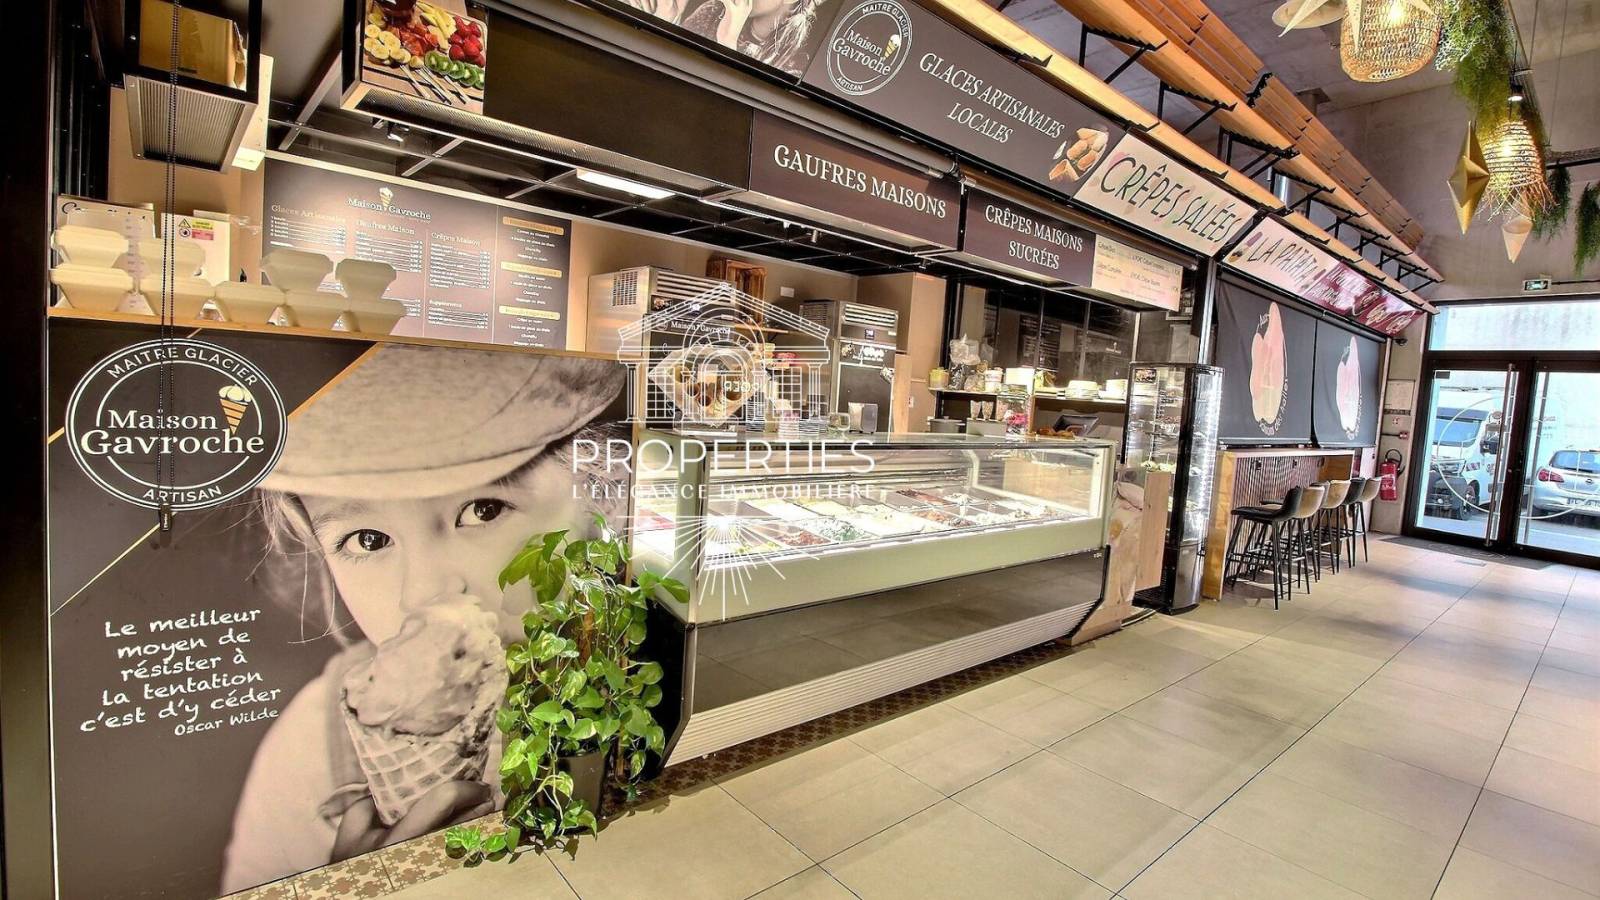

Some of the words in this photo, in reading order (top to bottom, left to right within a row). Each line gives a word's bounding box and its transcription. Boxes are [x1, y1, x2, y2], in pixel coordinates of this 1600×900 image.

[832, 37, 892, 77] Gavroche
[847, 29, 883, 57] Maison
[836, 76, 863, 92] ARTISAN
[919, 52, 983, 97] GLACES
[978, 84, 1066, 138] ARTISANALES
[947, 102, 1014, 144] LOCALES
[774, 143, 867, 193] GAUFRES
[870, 178, 946, 219] MAISONS
[347, 197, 383, 211] Maison
[388, 205, 431, 220] Gavroche
[1101, 157, 1191, 218] CRÊPES
[1172, 196, 1242, 243] SALÉES
[984, 204, 1032, 235] CRÊPES
[1032, 221, 1083, 253] MAISONS
[1008, 240, 1060, 270] SUCRÉES
[1247, 236, 1284, 263] LA
[106, 346, 180, 379] MAITRE
[184, 346, 259, 386] GLACIER
[108, 408, 218, 430] Maison
[80, 429, 265, 455] Gavroche
[142, 485, 223, 503] ARTISAN
[104, 621, 137, 638] Le
[149, 608, 262, 633] meilleur
[117, 637, 207, 663] moyen
[218, 628, 251, 645] de
[120, 655, 222, 682] résister
[232, 648, 248, 665] à
[143, 671, 264, 700] tentation
[80, 707, 146, 732] c'est
[158, 699, 200, 724] d'y
[210, 687, 281, 710] céder
[174, 719, 223, 736] Oscar
[230, 707, 280, 727] Wilde
